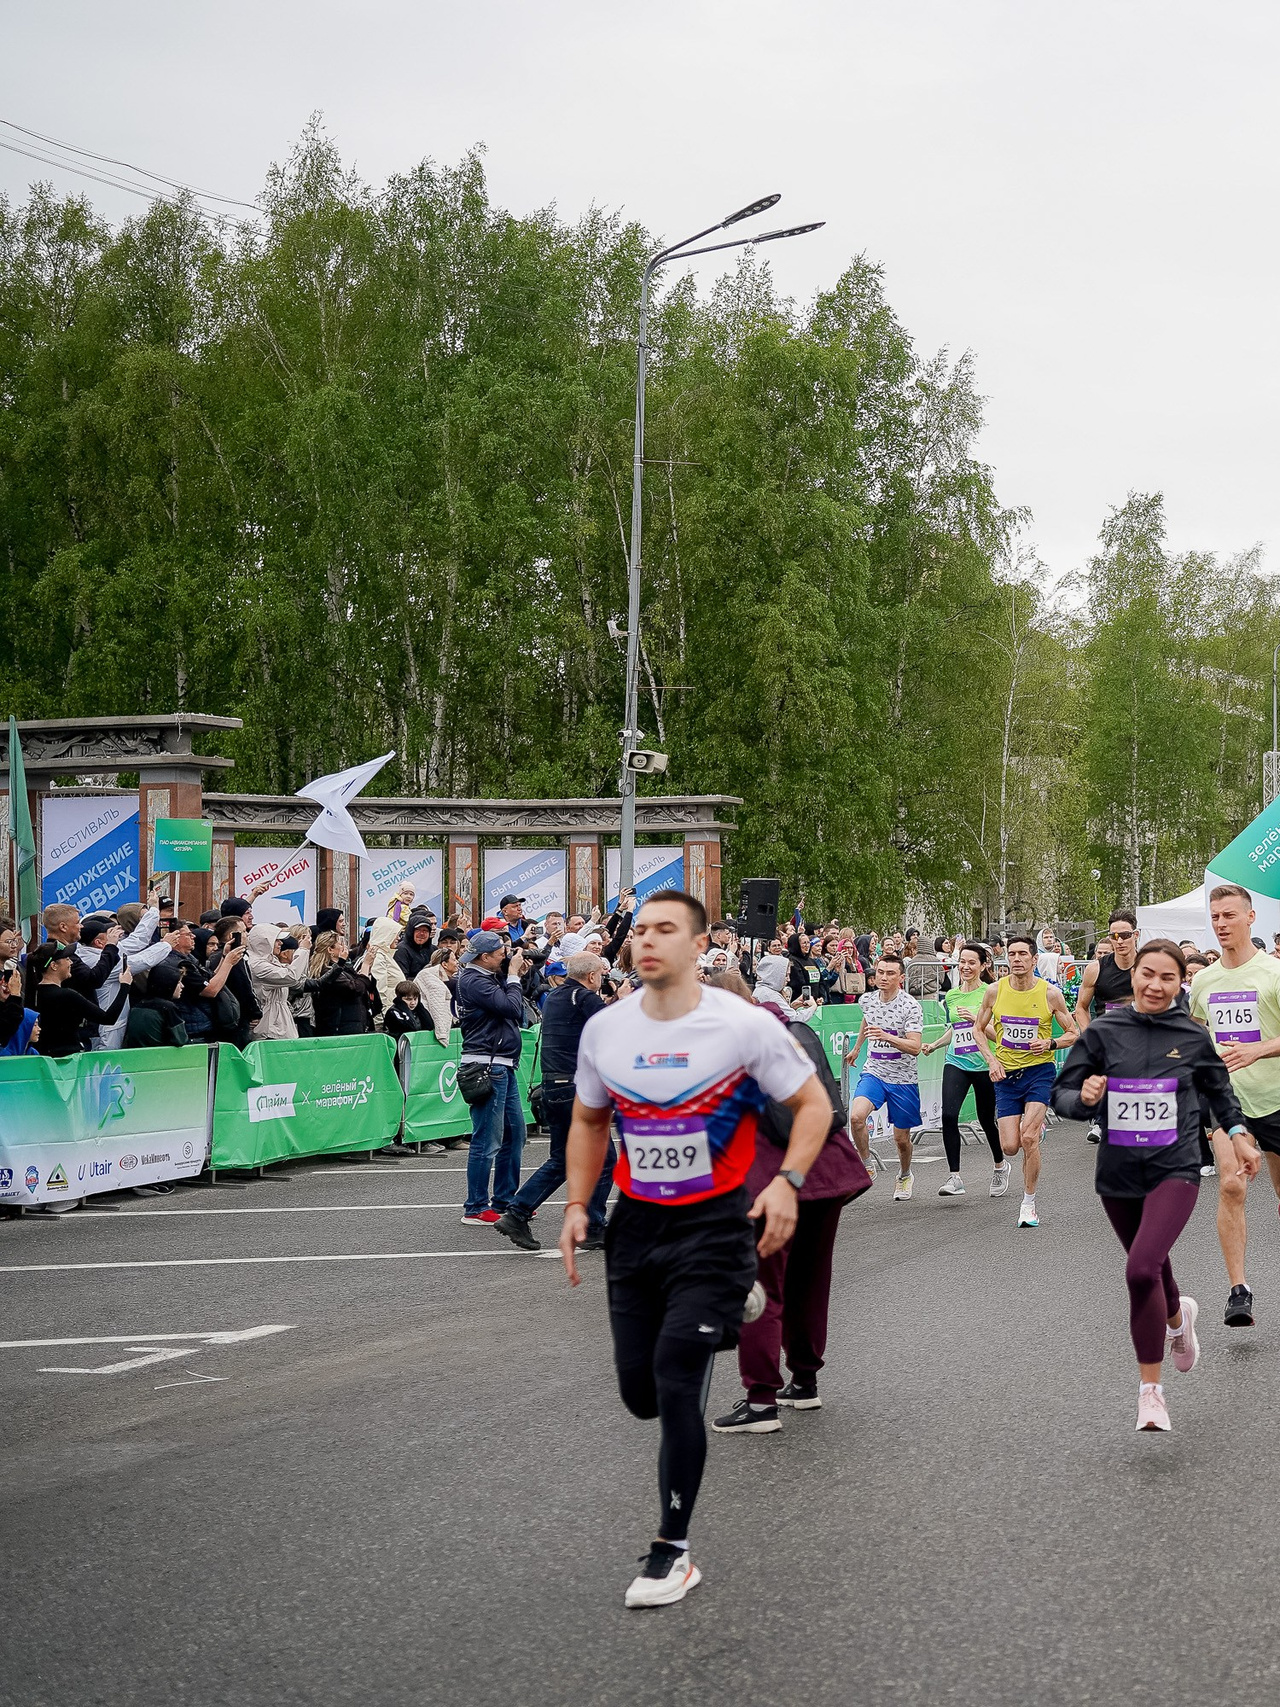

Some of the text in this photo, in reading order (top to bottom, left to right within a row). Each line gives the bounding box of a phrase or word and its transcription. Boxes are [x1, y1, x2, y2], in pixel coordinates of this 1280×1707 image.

[50, 808, 120, 860] ФЕСТИВАЛЬ
[55, 841, 134, 903] ДВИЖЕНИЕ
[243, 862, 279, 886] БЫТЬ
[366, 855, 436, 898] В ДВИЖЕНИИ
[371, 859, 407, 881] БЫТЬ
[490, 856, 559, 898] БЫТЬ ВМЕСТЕ
[73, 865, 138, 918] РВЫХ
[1216, 1009, 1252, 1024] 2165
[955, 1031, 975, 1043] 210
[1007, 1028, 1033, 1039] 2055
[322, 1078, 357, 1094] зелёный
[315, 1093, 354, 1109] марафон
[1117, 1101, 1170, 1121] 2152
[634, 1145, 697, 1169] 2289
[89, 1159, 112, 1178] Utair
